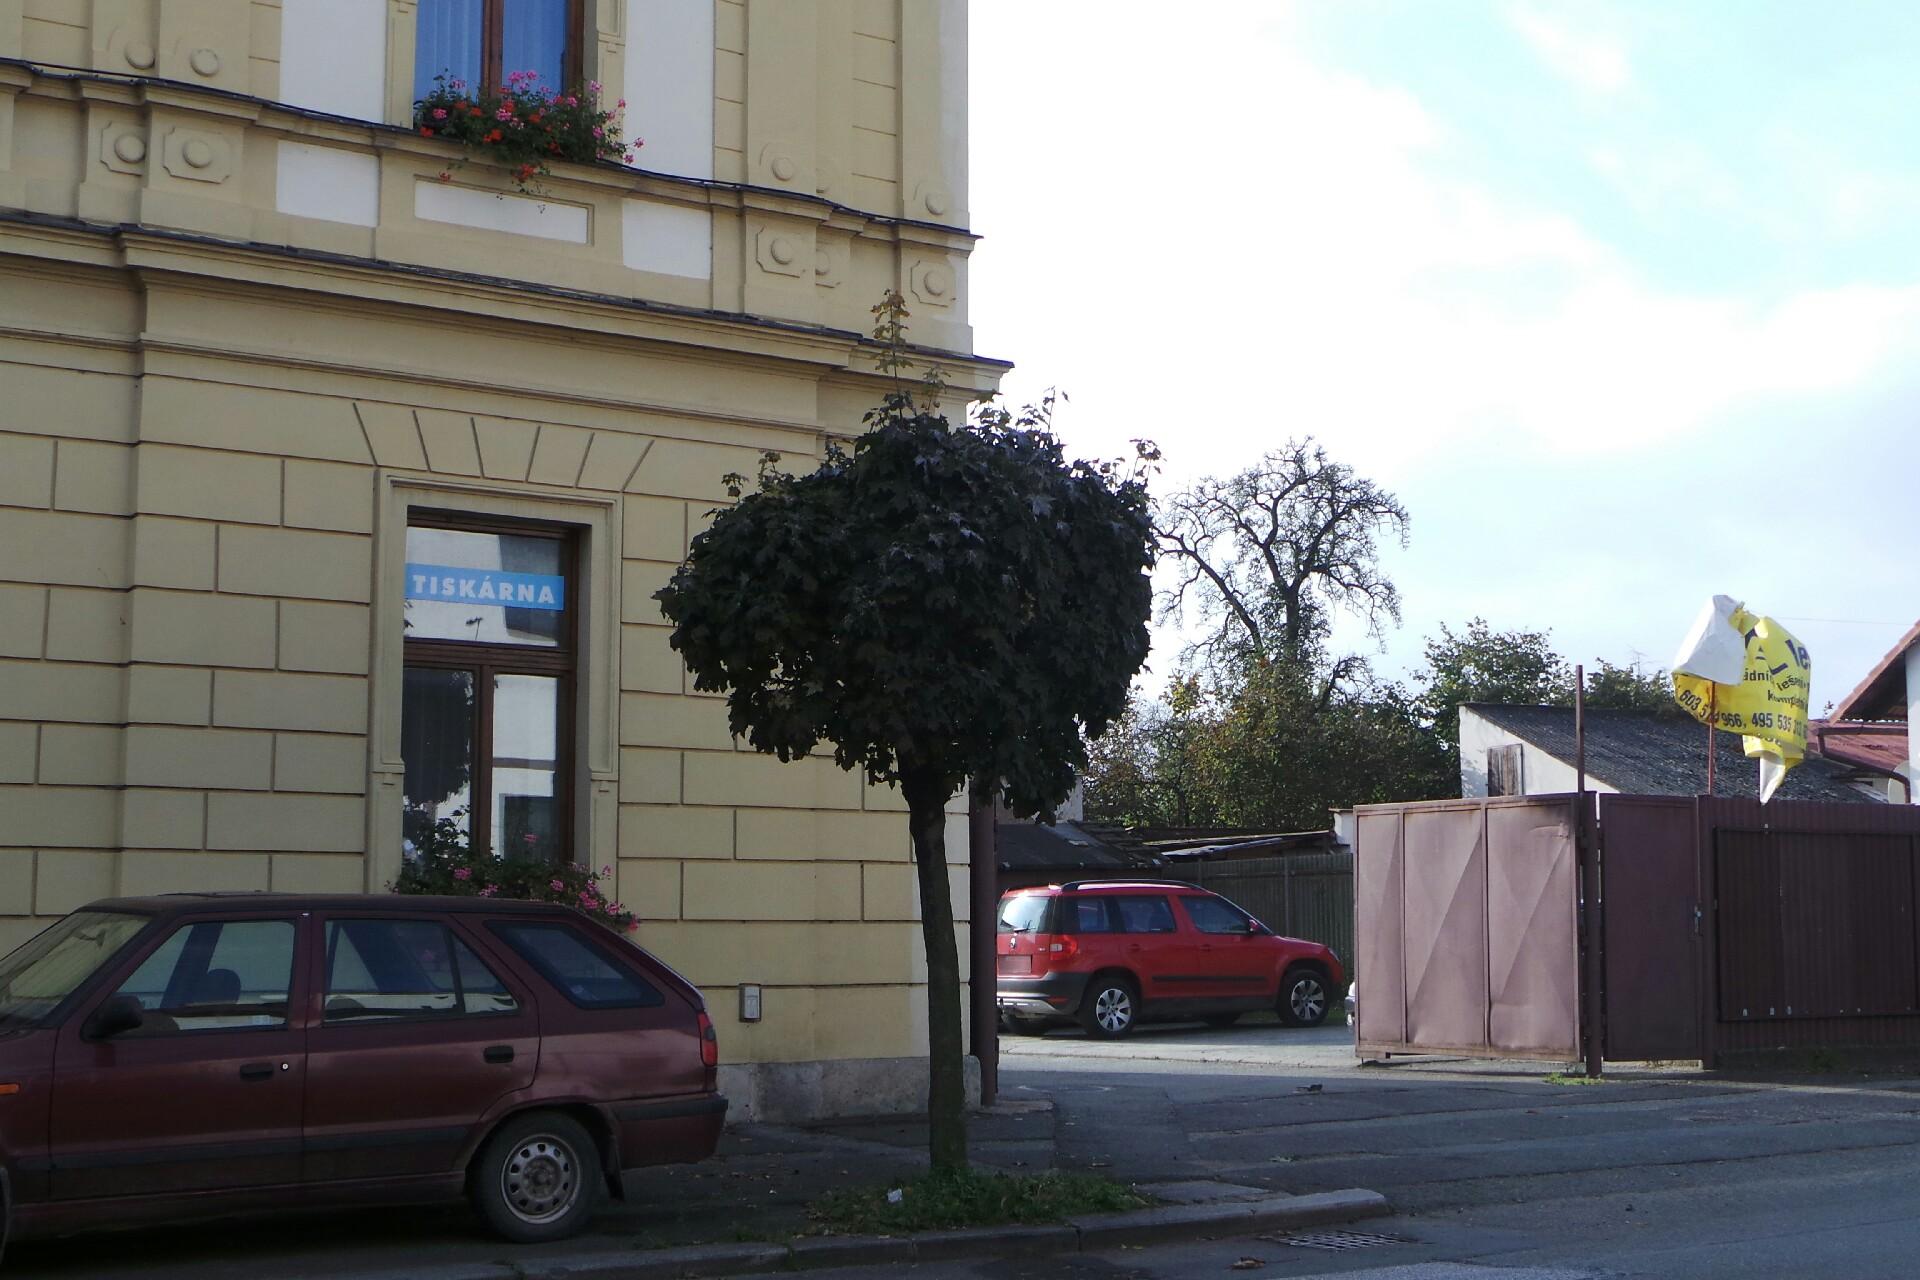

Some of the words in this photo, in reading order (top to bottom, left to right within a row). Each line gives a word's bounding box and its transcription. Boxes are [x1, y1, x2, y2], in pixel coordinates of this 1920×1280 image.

[412, 575, 555, 604] TISKÁRNA
[1680, 690, 1702, 710] 603
[1721, 713, 1746, 728] 966,
[1751, 712, 1773, 727] 495
[1777, 714, 1792, 731] 535
